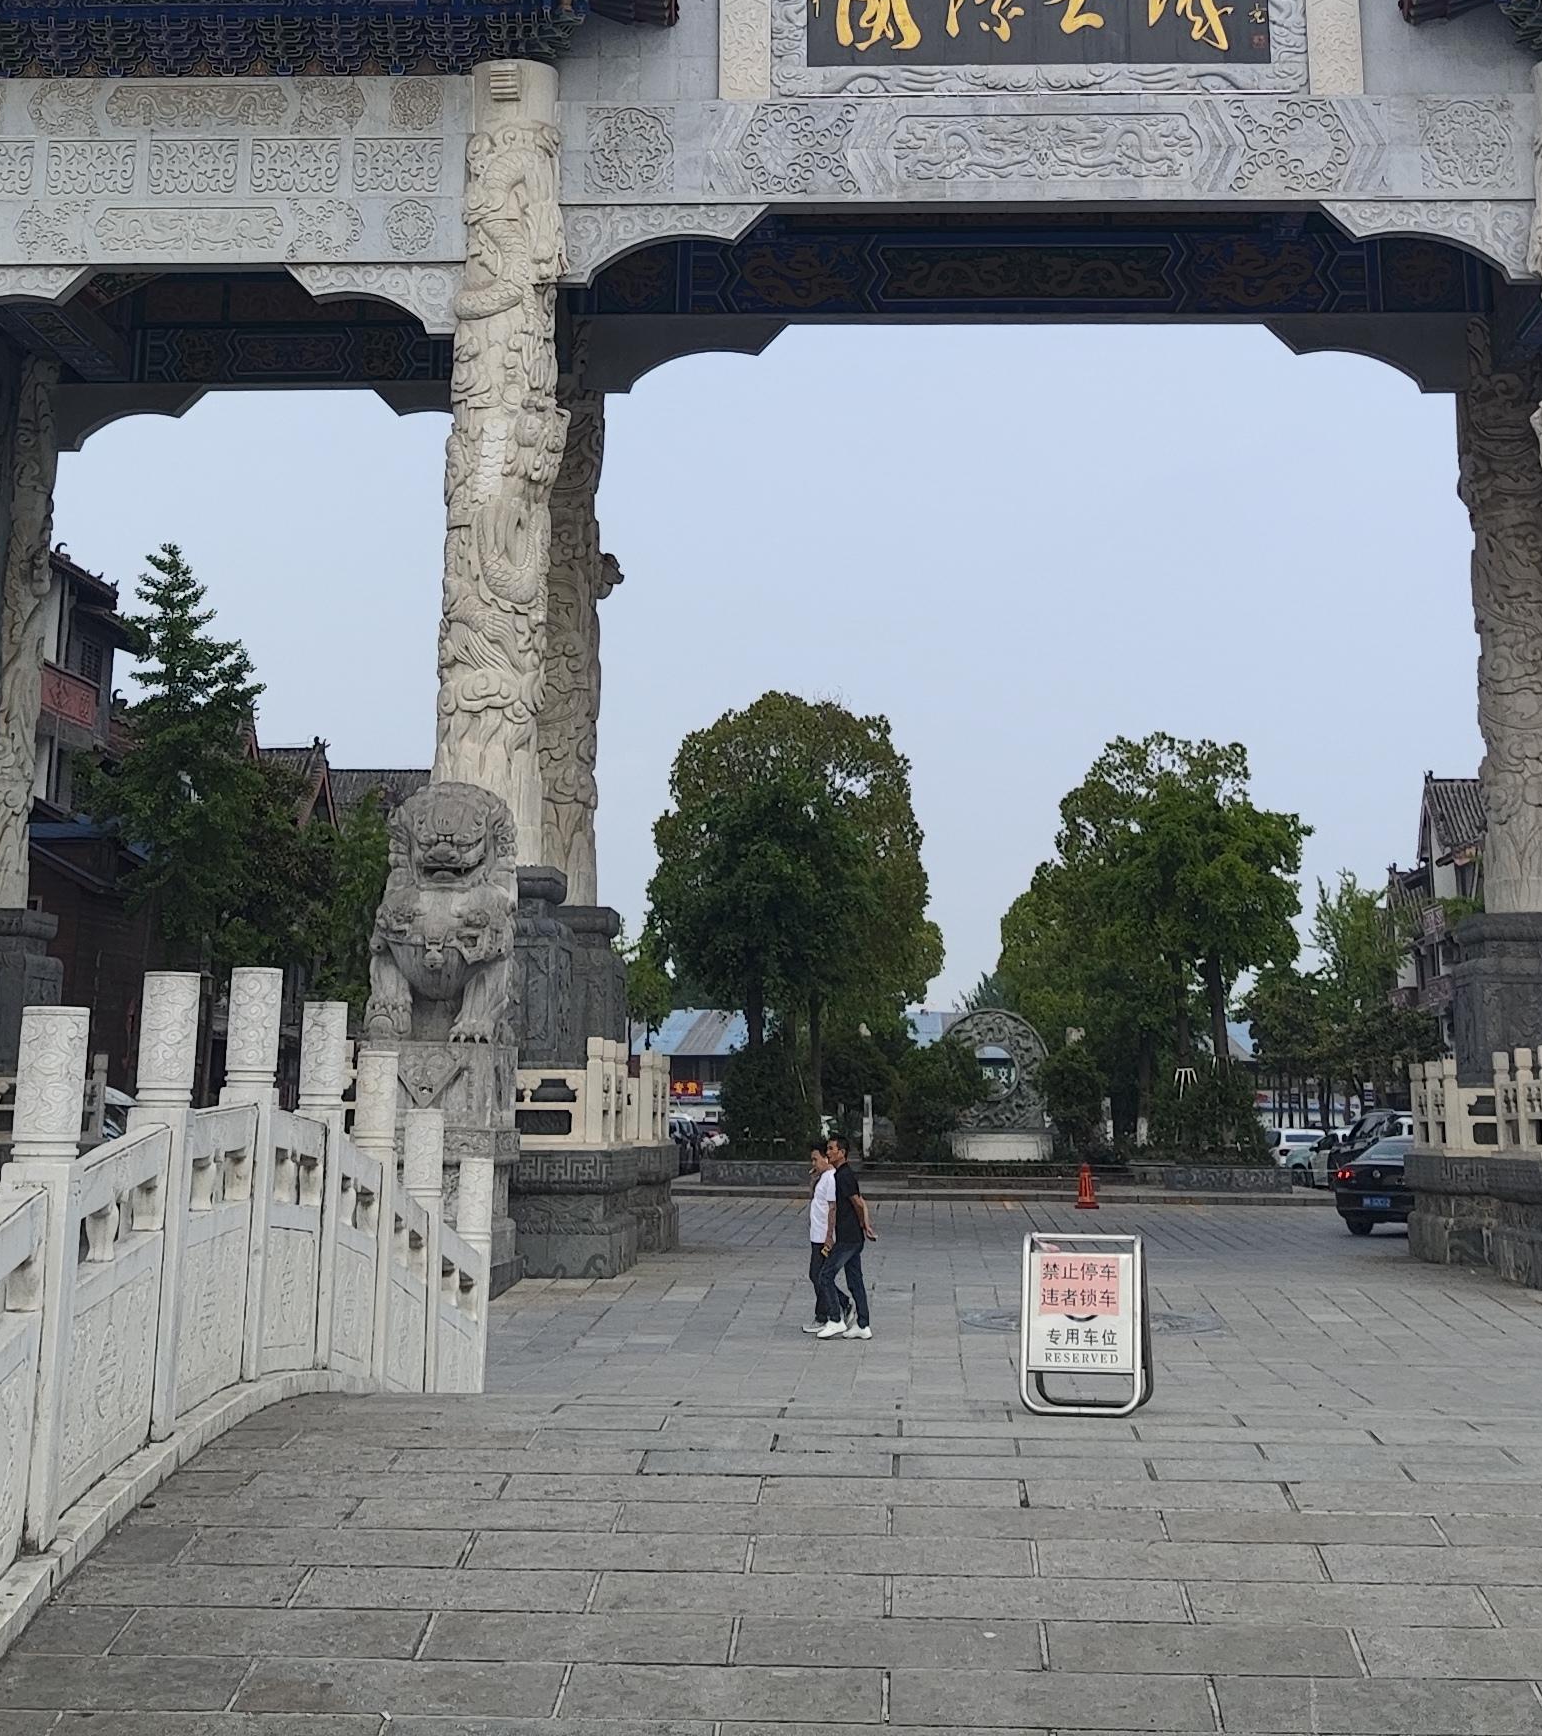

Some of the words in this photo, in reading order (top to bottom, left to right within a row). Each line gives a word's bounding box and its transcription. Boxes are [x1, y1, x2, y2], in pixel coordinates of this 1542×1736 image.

[1042, 1262, 1118, 1282] 禁止停车
[1041, 1287, 1118, 1308] 违者锁车
[1046, 1327, 1118, 1346] 专用车位
[1044, 1352, 1120, 1365] RESERVED
